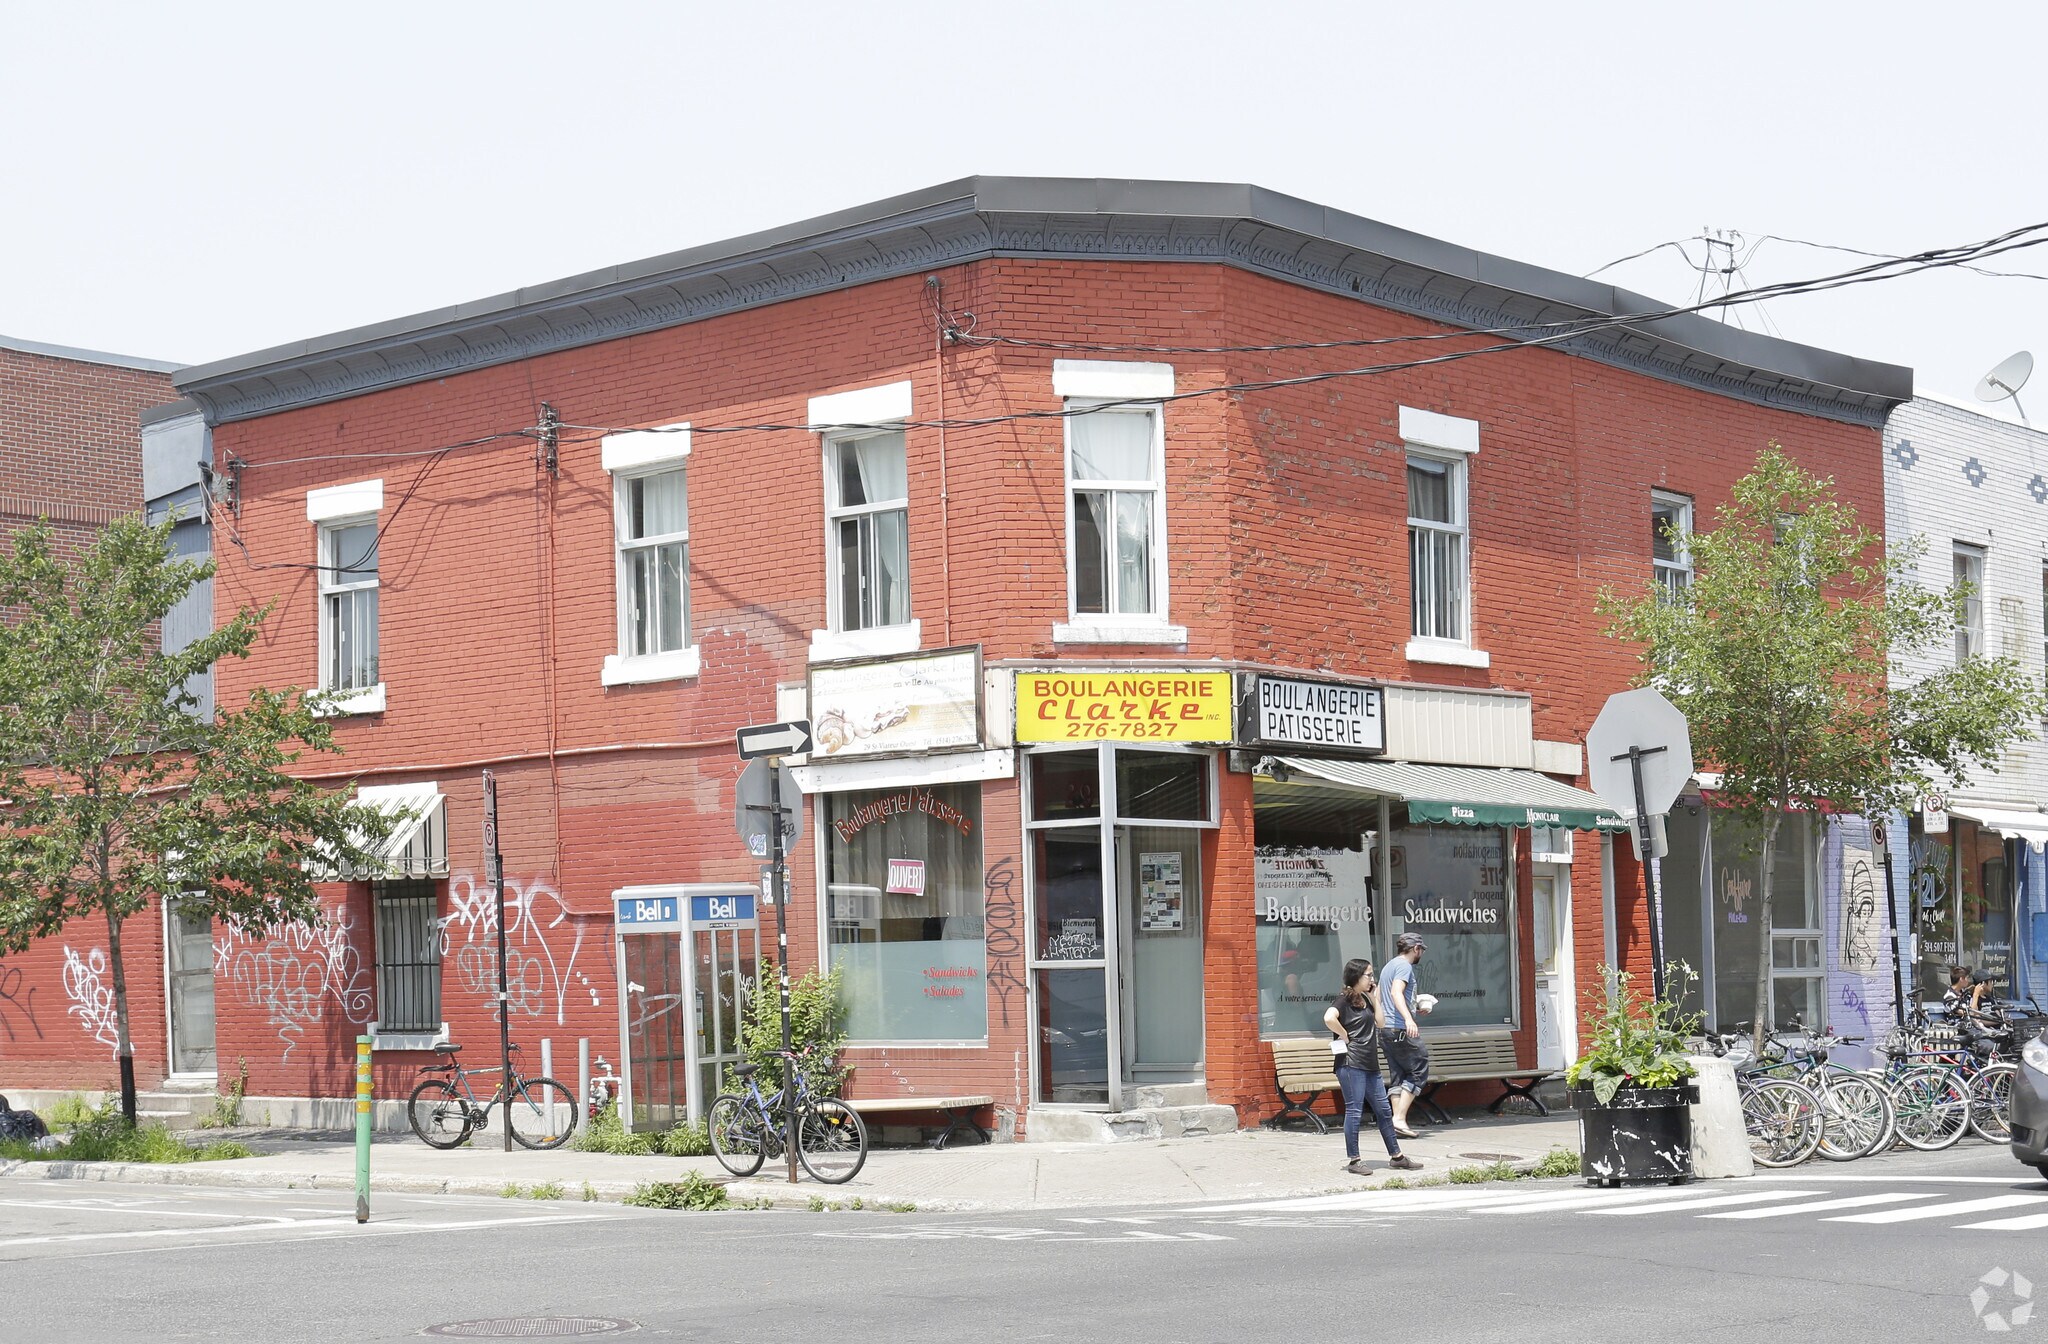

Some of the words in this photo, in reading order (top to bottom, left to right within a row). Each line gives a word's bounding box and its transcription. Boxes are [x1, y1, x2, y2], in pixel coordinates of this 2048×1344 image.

[1034, 680, 1213, 697] BOULANGERIE
[1263, 683, 1375, 717] BOULANGERIE
[1066, 723, 1178, 737] 276-7827
[1269, 712, 1362, 744] PATISSERIE
[834, 793, 908, 844] Boulangerie
[1452, 806, 1474, 818] Pizza
[889, 865, 924, 890] OUVERT
[636, 900, 661, 921] Bell
[709, 897, 737, 918] Bell
[1265, 896, 1372, 931] Boulangerie
[1405, 899, 1497, 924] Sandwiches
[929, 985, 964, 998] Salades
[1285, 994, 1301, 1002] votre
[1301, 993, 1323, 1002] service
[1434, 990, 1453, 998] service
[1454, 989, 1472, 999] depuis
